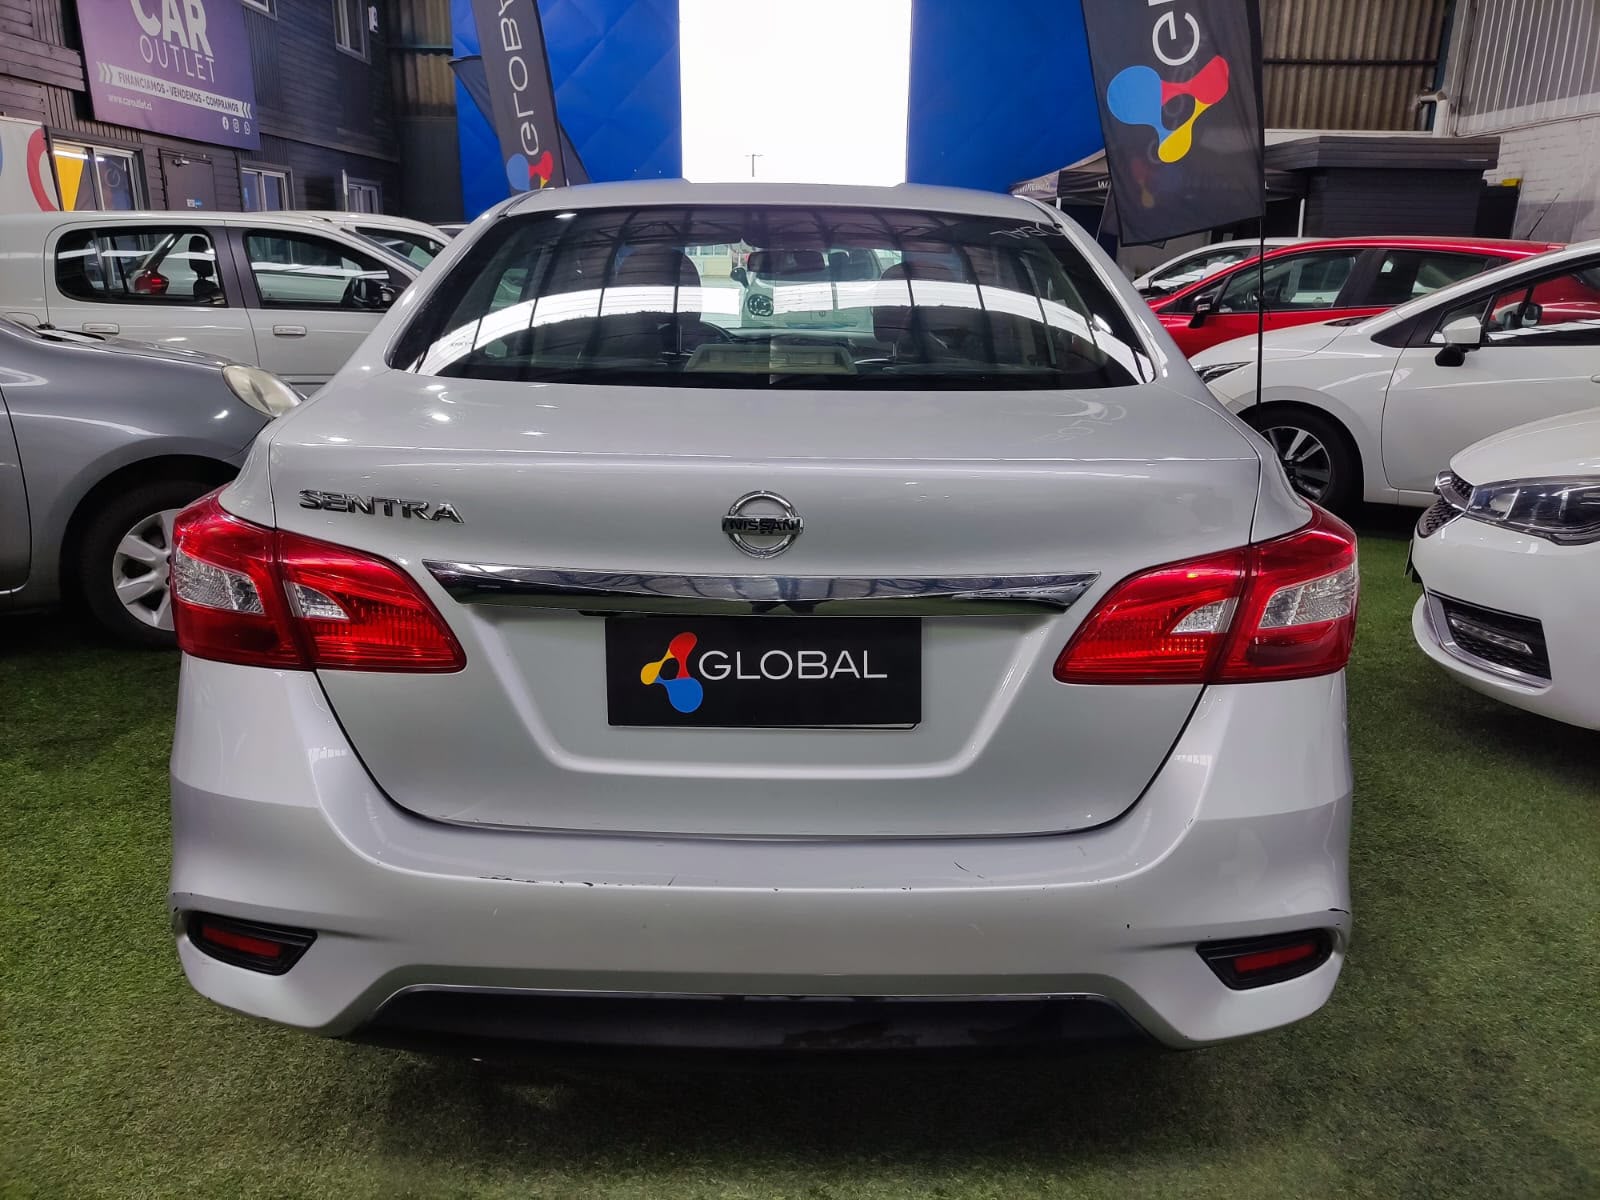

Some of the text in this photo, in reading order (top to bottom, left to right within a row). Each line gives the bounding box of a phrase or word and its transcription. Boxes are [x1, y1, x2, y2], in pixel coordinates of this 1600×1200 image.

[131, 0, 214, 57] CAR
[139, 35, 215, 83] OUTLET
[118, 71, 239, 113] FINANCIAMOS VENDEMOS COMPRAMOS
[298, 489, 465, 524] SENTRA
[728, 517, 796, 531] NISSAN
[698, 649, 888, 681] GLOBAL
